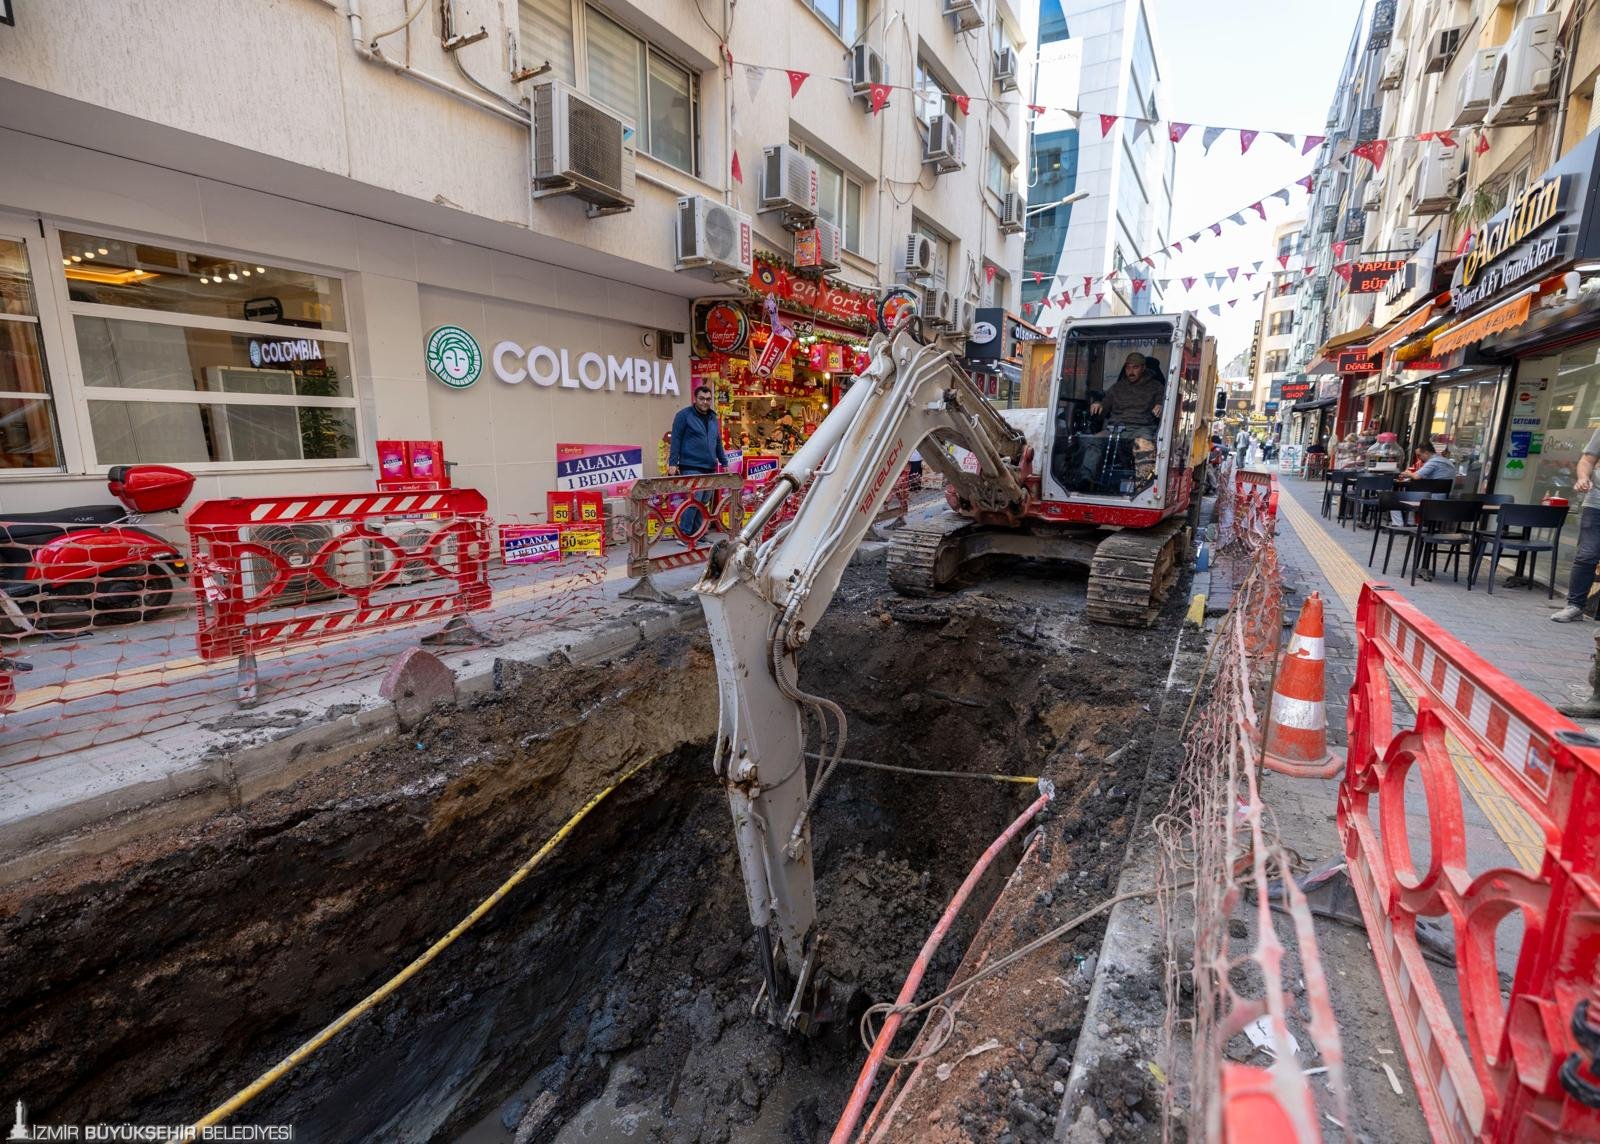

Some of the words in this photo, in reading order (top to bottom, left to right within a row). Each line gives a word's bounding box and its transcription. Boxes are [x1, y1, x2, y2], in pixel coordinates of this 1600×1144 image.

[741, 223, 751, 266] VESTEL
[1455, 286, 1479, 314] Döner
[1479, 275, 1488, 299] &
[1487, 269, 1499, 296] Ev
[1499, 226, 1560, 288] Yemekleri
[261, 339, 322, 364] COLOMBIA
[830, 356, 839, 364] 50
[493, 341, 680, 397] COLOMBIA
[565, 463, 573, 474] 1
[575, 453, 629, 473] ALANA
[753, 464, 772, 473] ALANA
[568, 478, 575, 490] 1
[578, 468, 638, 488] BEDAVA
[556, 510, 567, 519] 50
[584, 509, 596, 518] 50
[516, 535, 549, 546] ALANA
